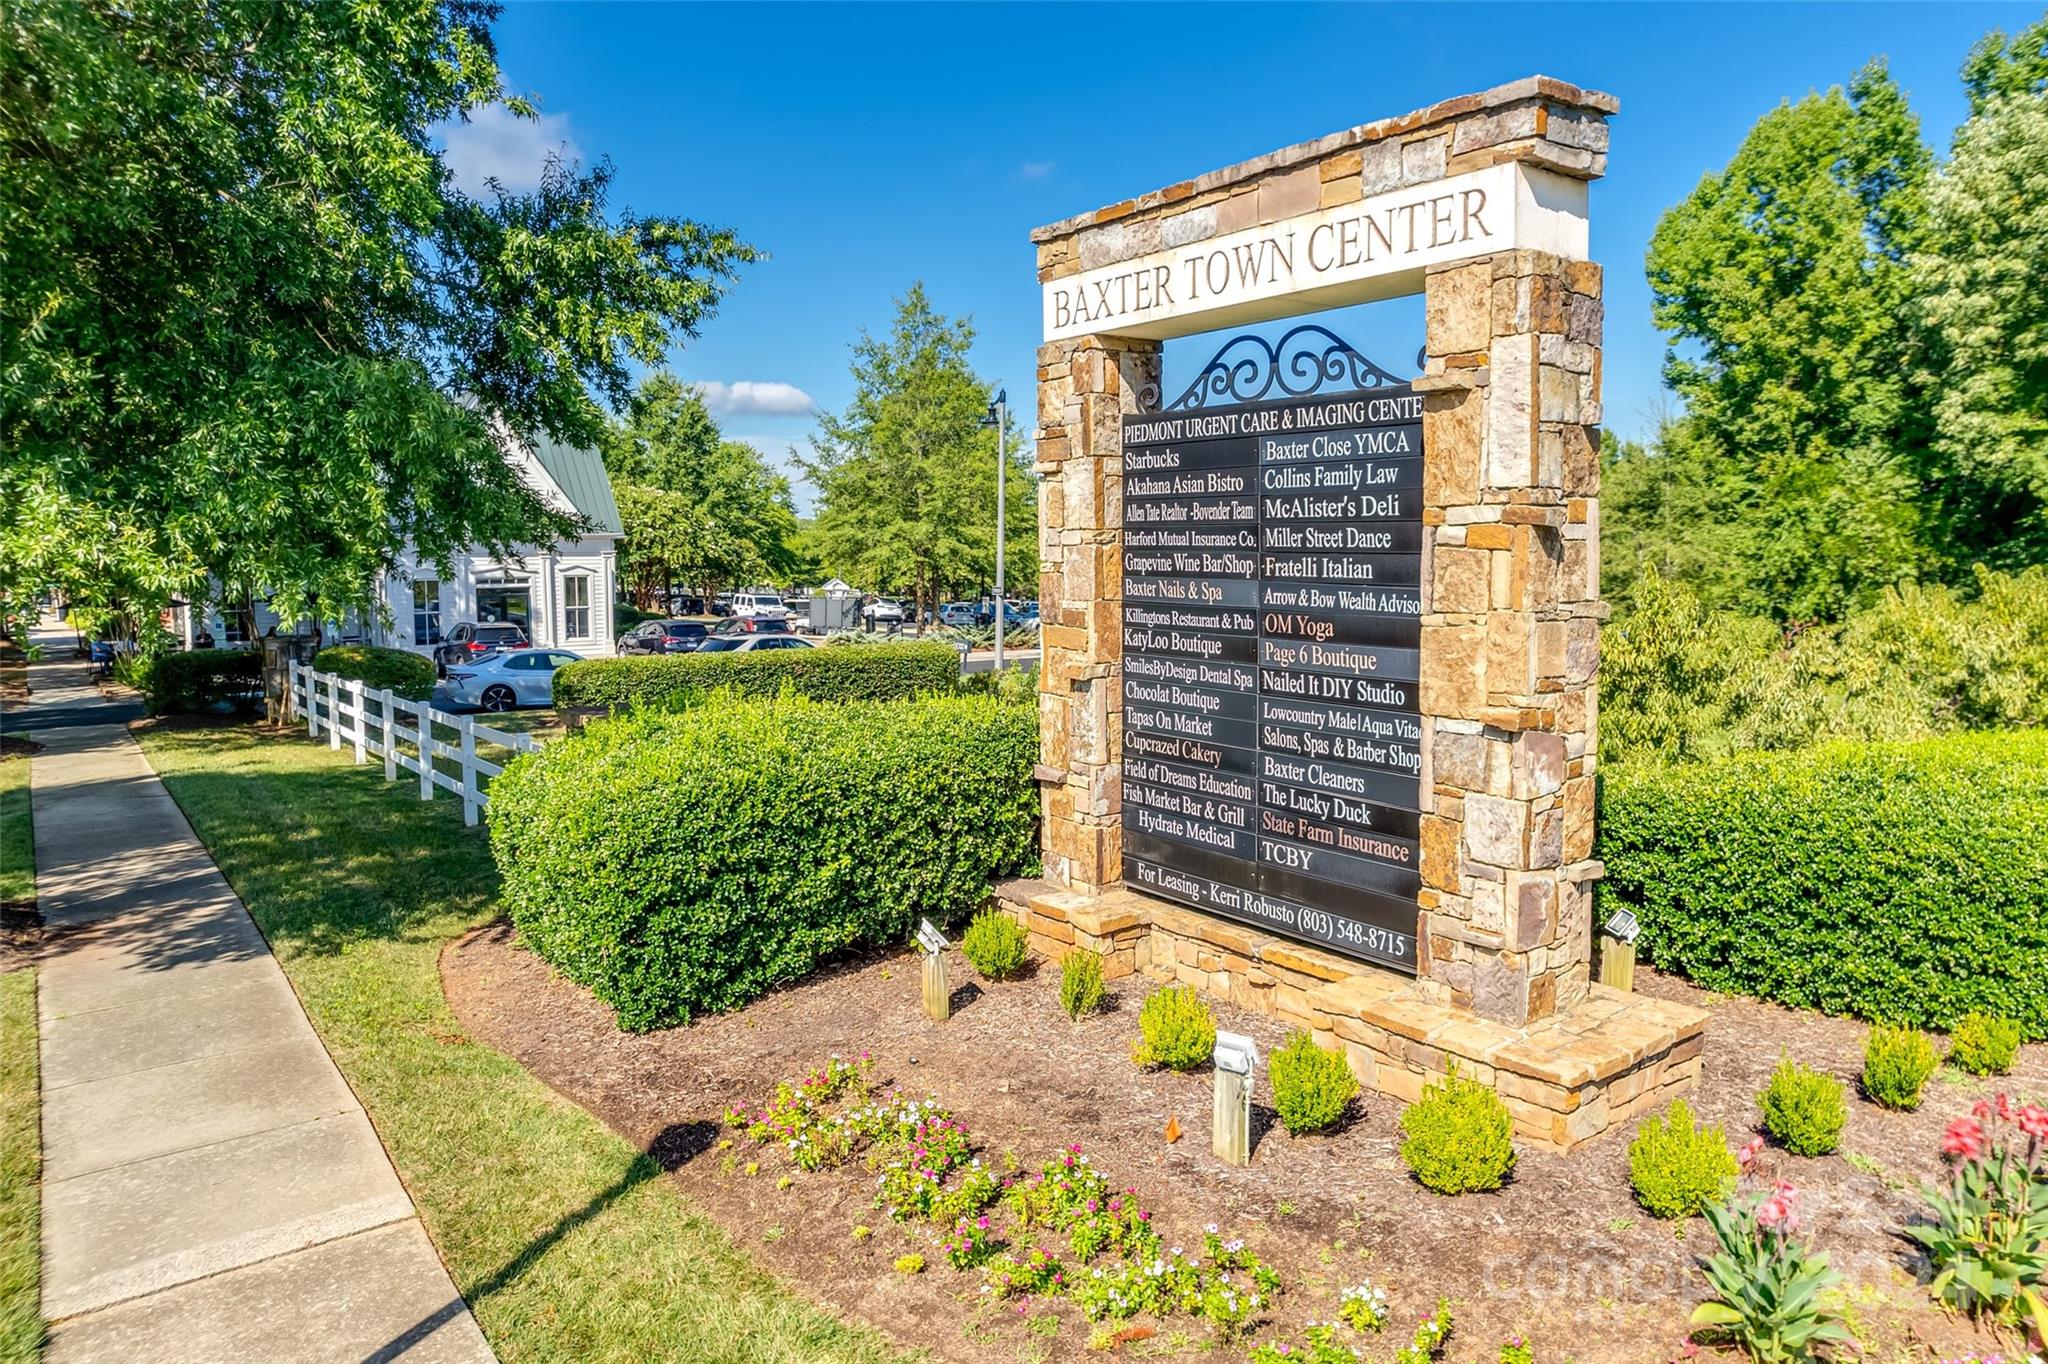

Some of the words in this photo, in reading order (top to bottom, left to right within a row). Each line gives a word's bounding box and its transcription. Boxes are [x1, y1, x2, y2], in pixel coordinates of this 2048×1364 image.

[1053, 263, 1175, 329] BAXTER
[1184, 232, 1296, 301] TOWN
[1308, 187, 1493, 273] CENTER
[1124, 417, 1182, 443] PIEDMONT
[1186, 416, 1238, 438] URGENT
[1241, 410, 1278, 433] CARE
[1282, 410, 1293, 429] &
[1296, 401, 1364, 428] IMAGING
[1368, 396, 1424, 423] CENTE
[1126, 449, 1179, 470] Starbucks
[1266, 441, 1308, 460] Baxter
[1312, 436, 1350, 457] Close
[1354, 431, 1410, 454] YMCA
[1127, 478, 1171, 496] Akahana
[1173, 476, 1204, 493] Asian
[1208, 473, 1243, 492] Bistro
[1265, 469, 1310, 489] Collins
[1314, 465, 1362, 490] Family
[1366, 464, 1398, 484] Law
[1126, 504, 1144, 521] Allen
[1146, 504, 1160, 520] Tate
[1161, 504, 1187, 520] Realtor
[1231, 501, 1254, 519] Team
[1266, 496, 1356, 518] McAlister's
[1361, 494, 1400, 517] Deli
[1124, 531, 1157, 546] Harford
[1158, 531, 1190, 547] Mutual
[1192, 531, 1237, 547] Insurance
[1239, 531, 1256, 547] Co.
[1266, 528, 1302, 548] Miller
[1306, 528, 1342, 548] Street
[1346, 527, 1392, 548] Dance
[1126, 554, 1172, 575] Grapevine
[1174, 553, 1200, 572] Wine
[1202, 552, 1254, 579] Bar/Shop
[1266, 556, 1317, 578] Fratelli
[1322, 557, 1372, 579] Italian
[1126, 579, 1156, 597] Baxter
[1159, 580, 1185, 598] Nails
[1188, 581, 1198, 599] &
[1201, 582, 1222, 605] Spa
[1264, 589, 1297, 606] Arrow
[1299, 589, 1308, 606] &
[1311, 589, 1335, 608] Bow
[1338, 591, 1376, 612] Wealth
[1379, 592, 1422, 615] Adviso
[1126, 608, 1170, 627] Killingtons
[1172, 611, 1219, 628] Restaurant
[1222, 612, 1231, 629] &
[1234, 614, 1253, 630] Pub
[1265, 613, 1292, 633] OM
[1296, 616, 1334, 641] Yoga
[1124, 629, 1168, 650] KatyLoo
[1171, 634, 1222, 656] Boutique
[1265, 642, 1296, 667] Page
[1300, 644, 1308, 664] 6
[1311, 645, 1377, 672] Boutique
[1125, 657, 1198, 682] SmilesByDesign
[1200, 664, 1231, 686] Dental
[1234, 669, 1252, 689] Spa
[1262, 670, 1304, 694] Nailed
[1308, 675, 1319, 696] It
[1323, 677, 1353, 699] DIY
[1357, 680, 1405, 705] Studio
[1126, 681, 1169, 702] Chocolat
[1172, 687, 1220, 712] Boutique
[1126, 706, 1154, 728] Tapas
[1156, 711, 1171, 728] On
[1174, 714, 1212, 736] Market
[1264, 702, 1325, 730] Lowcountry
[1126, 731, 1179, 757] Cupcrazed
[1182, 739, 1222, 769] Cakery
[1264, 726, 1300, 753] Salons,
[1304, 732, 1329, 756] Spas
[1333, 736, 1344, 756] &
[1348, 739, 1386, 766] Barber
[1124, 759, 1146, 778] Field
[1149, 765, 1159, 781] of
[1161, 766, 1197, 789] Dreams
[1200, 773, 1251, 800] Education
[1264, 756, 1304, 782] Baxter
[1308, 766, 1364, 793] Cleaners
[1123, 782, 1142, 802] Fish
[1145, 786, 1180, 812] Market
[1182, 794, 1201, 816] Bar
[1204, 802, 1214, 818] &
[1218, 802, 1245, 827] Grill
[1263, 783, 1286, 806] The
[1290, 791, 1330, 820] Lucky
[1333, 799, 1371, 825] Duck
[1139, 810, 1182, 835] Hydrate
[1186, 821, 1234, 849] Medical
[1263, 811, 1294, 835] State
[1298, 819, 1333, 845] Farm
[1338, 827, 1409, 862] Insurance
[1262, 841, 1312, 870] TCBY
[1138, 862, 1156, 882] For
[1158, 869, 1199, 900] Leasing
[1210, 882, 1240, 908] Kerri
[1244, 892, 1294, 924] Robusto
[1298, 907, 1333, 939] (803)
[1337, 919, 1405, 956] 548-8715
